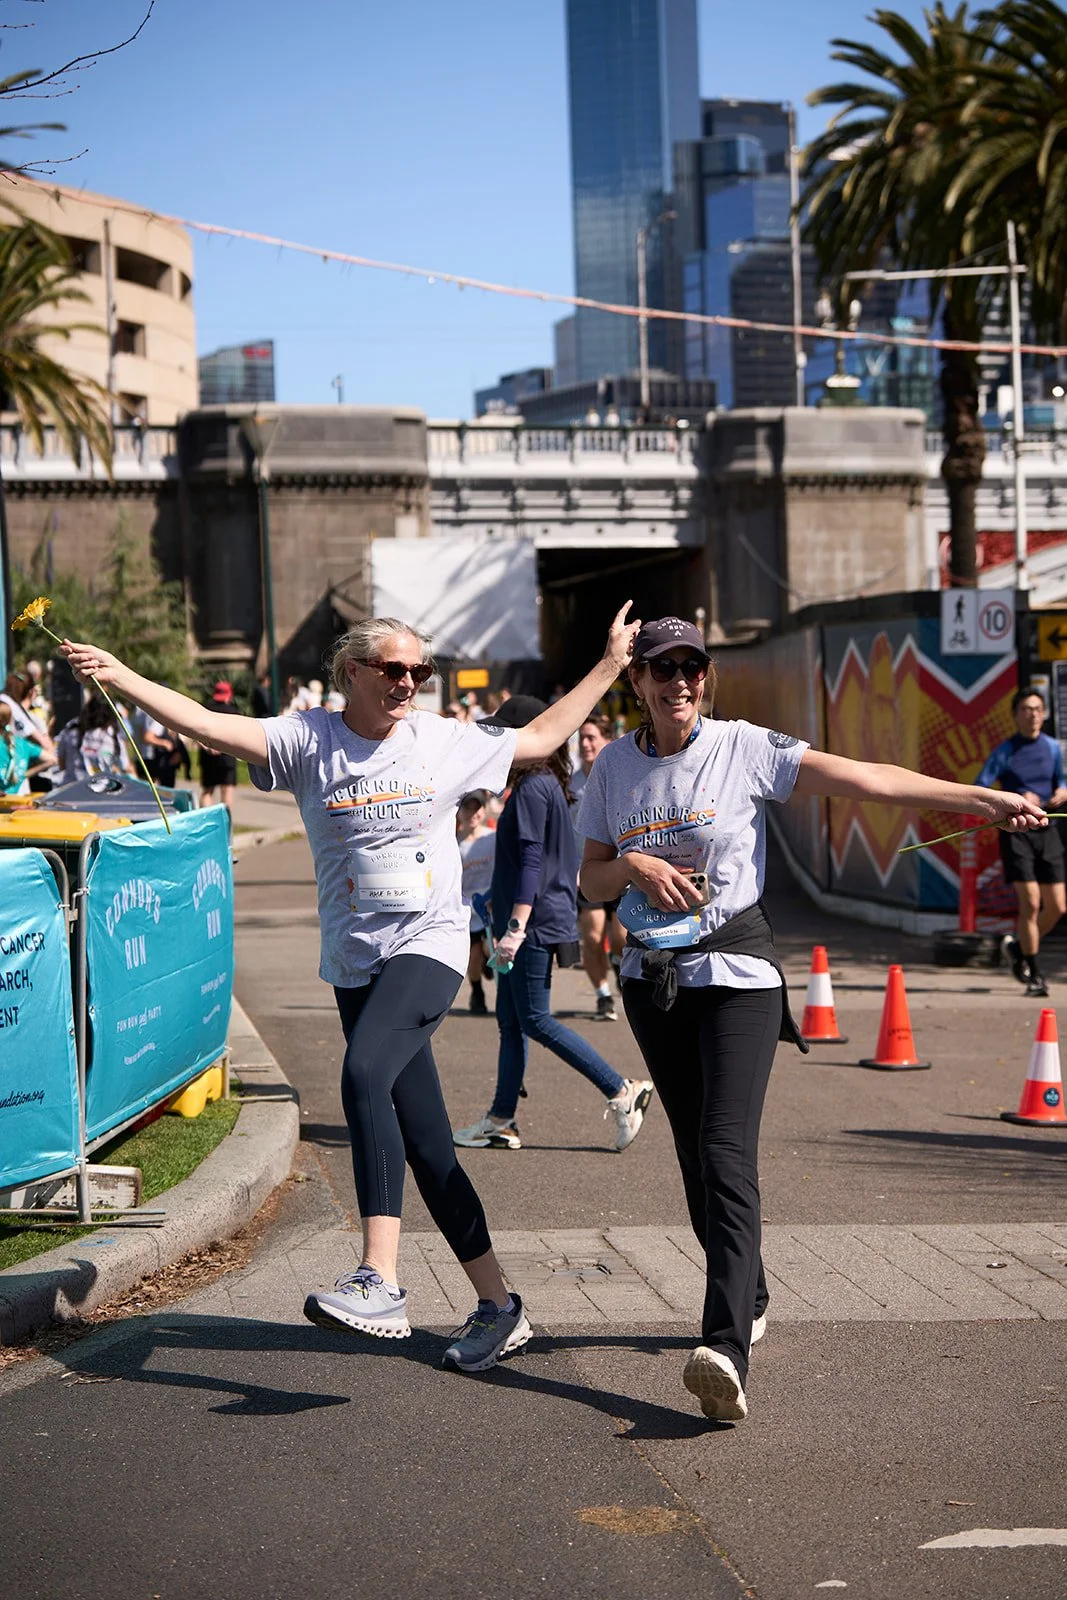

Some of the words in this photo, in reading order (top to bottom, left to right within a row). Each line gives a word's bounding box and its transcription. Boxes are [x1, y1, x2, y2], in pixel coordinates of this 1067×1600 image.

[986, 609, 1007, 632] 10
[333, 780, 429, 803] CONNOR'S
[363, 803, 401, 820] RUN
[620, 805, 708, 835] CONNOR'S
[643, 831, 679, 849] RUN
[106, 880, 161, 938] CONNOR'S
[646, 914, 667, 923] RUN
[0, 932, 46, 956] CANCER
[125, 935, 146, 970] RUN
